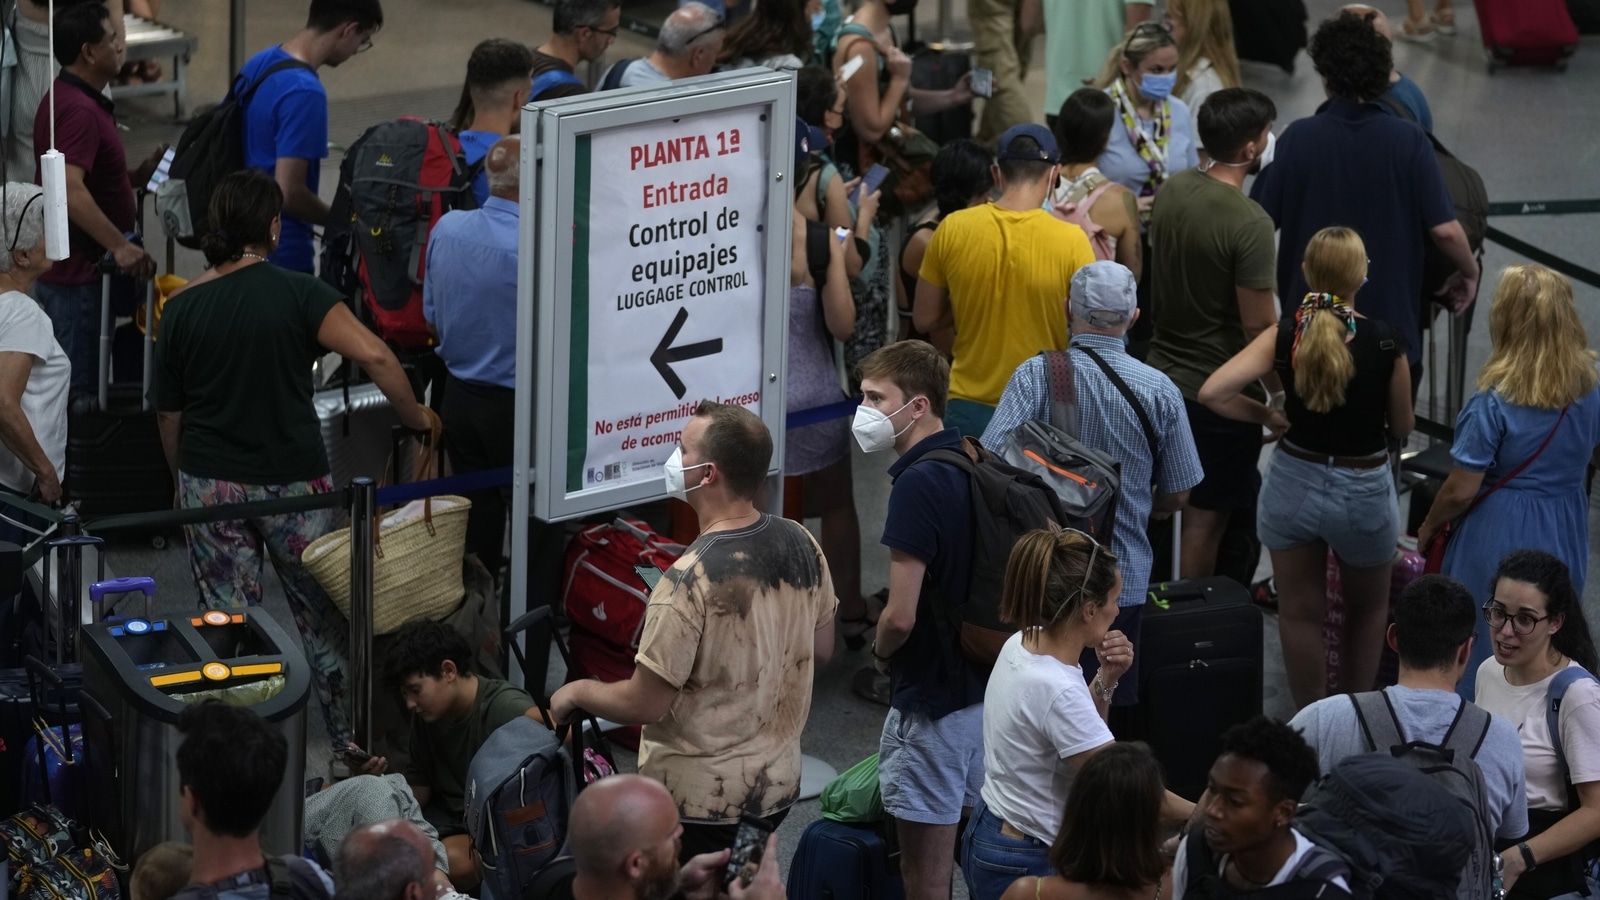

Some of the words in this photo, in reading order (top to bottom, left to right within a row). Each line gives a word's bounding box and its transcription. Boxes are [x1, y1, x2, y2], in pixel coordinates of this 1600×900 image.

[630, 135, 710, 170] PLANTA
[643, 173, 729, 209] Entrada
[628, 211, 708, 247] Control
[716, 206, 740, 231] de
[631, 243, 738, 284] equipajes
[617, 283, 684, 311] LUGGAGE
[689, 270, 748, 297] CONTROL
[595, 421, 613, 436] No
[616, 413, 642, 431] está
[645, 401, 698, 428] permitid
[621, 435, 637, 450] de
[641, 430, 682, 446] acomp
